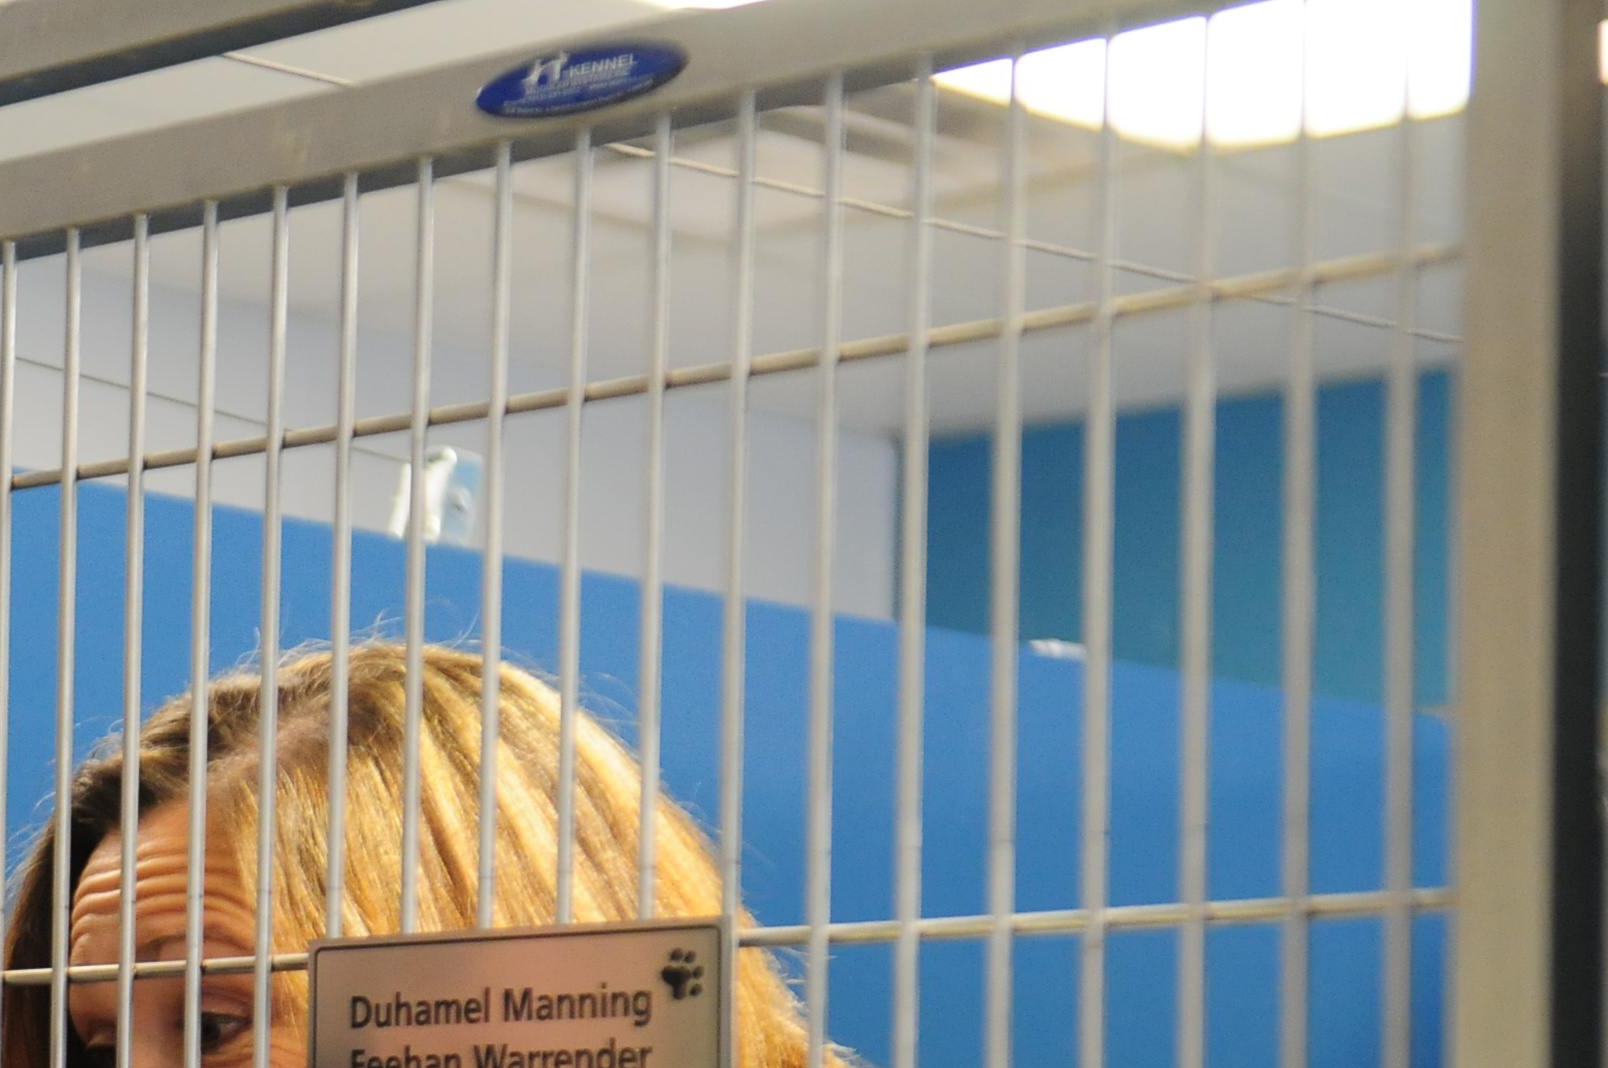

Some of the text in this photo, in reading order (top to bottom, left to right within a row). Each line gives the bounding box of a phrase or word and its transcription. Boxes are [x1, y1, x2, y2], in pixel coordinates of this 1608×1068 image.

[569, 52, 638, 78] KENNEL
[350, 982, 653, 1029] Duhamel Manning
